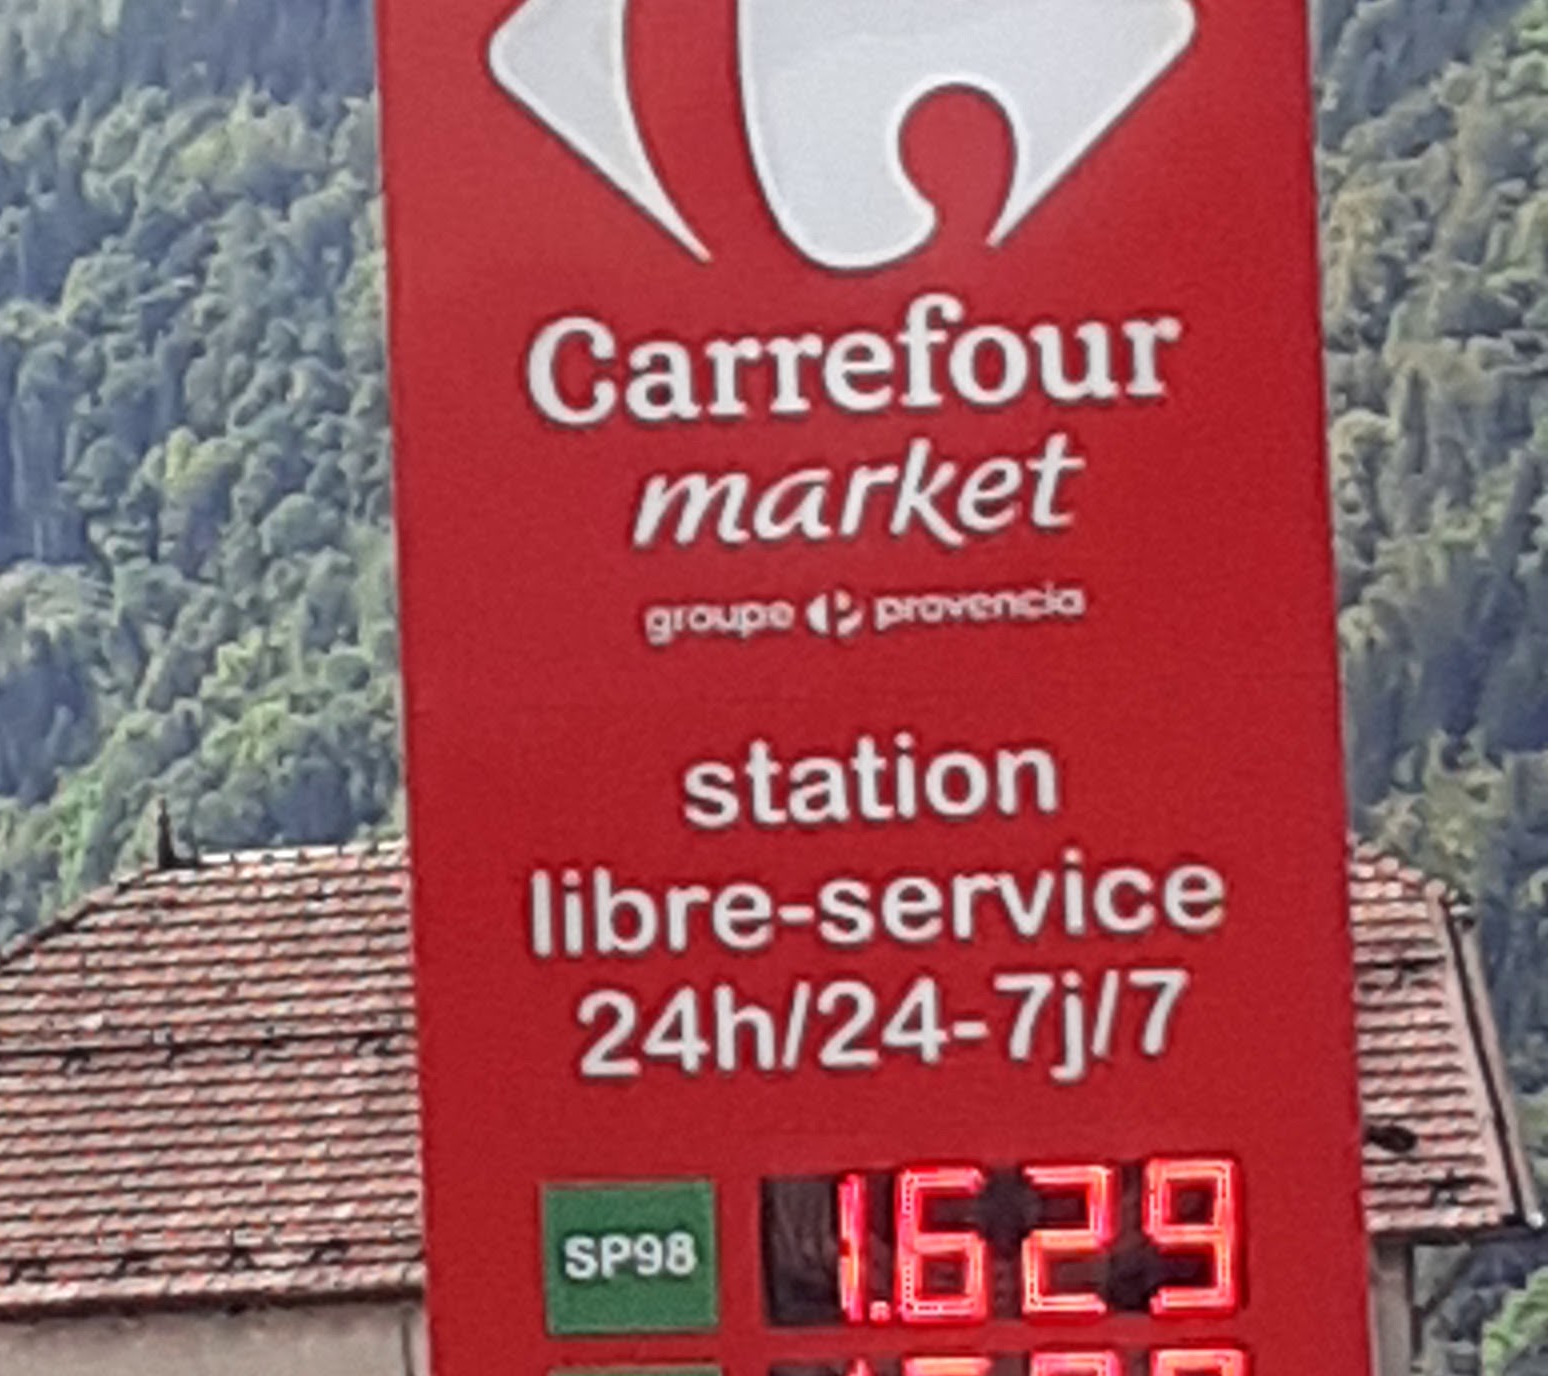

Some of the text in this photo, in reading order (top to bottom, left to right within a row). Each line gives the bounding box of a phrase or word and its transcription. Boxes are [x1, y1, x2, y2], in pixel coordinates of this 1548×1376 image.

[526, 292, 1183, 426] Carrefour
[632, 432, 1086, 547] market
[644, 584, 1086, 645] groupe provencia
[683, 731, 1059, 829] station
[530, 848, 1225, 958] libre-service
[577, 968, 1189, 1081] 24h/24-7j/7
[564, 1232, 698, 1280] SP98
[838, 1158, 1239, 1324] 1.629
